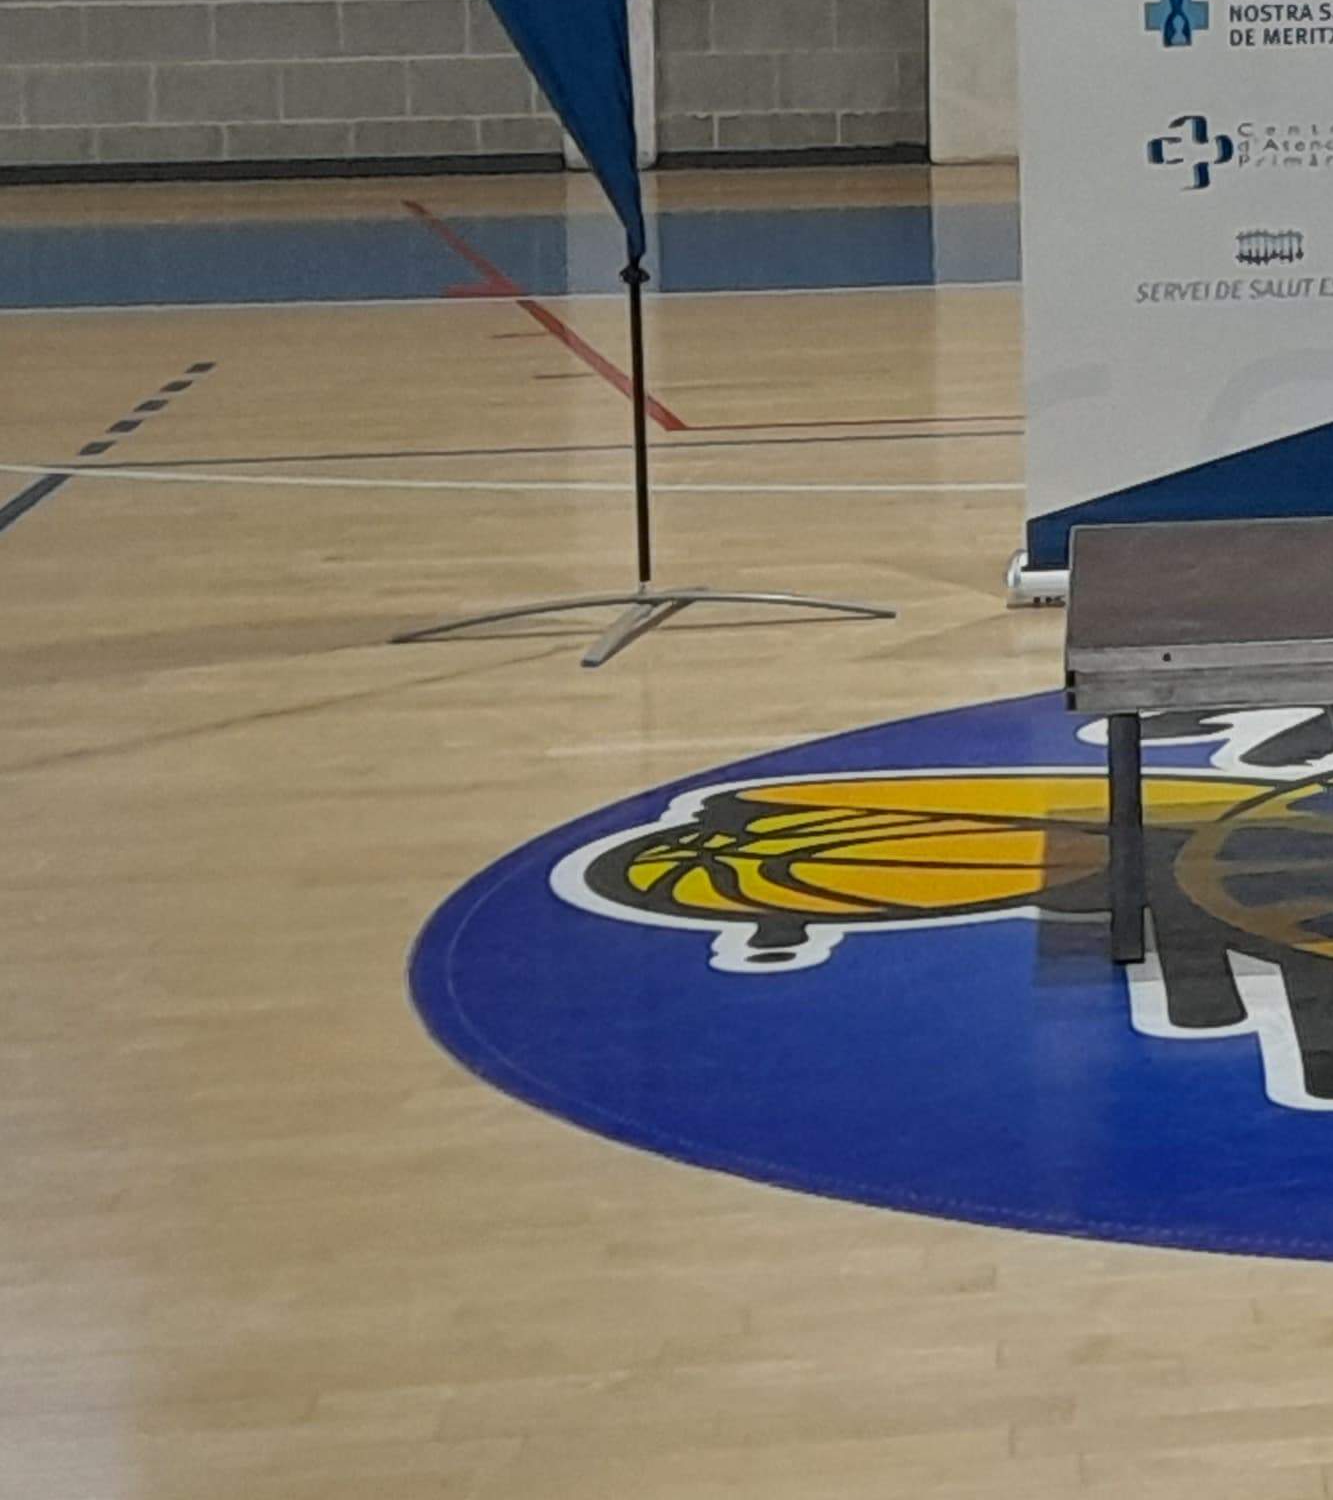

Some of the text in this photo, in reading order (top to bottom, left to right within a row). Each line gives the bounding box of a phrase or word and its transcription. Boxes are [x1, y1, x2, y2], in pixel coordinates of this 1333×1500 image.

[1229, 3, 1314, 23] NOSTRA
[1229, 28, 1255, 46] DE
[1136, 281, 1210, 304] SERVEI
[1215, 280, 1241, 300] DE
[1249, 278, 1314, 299] SALUT
